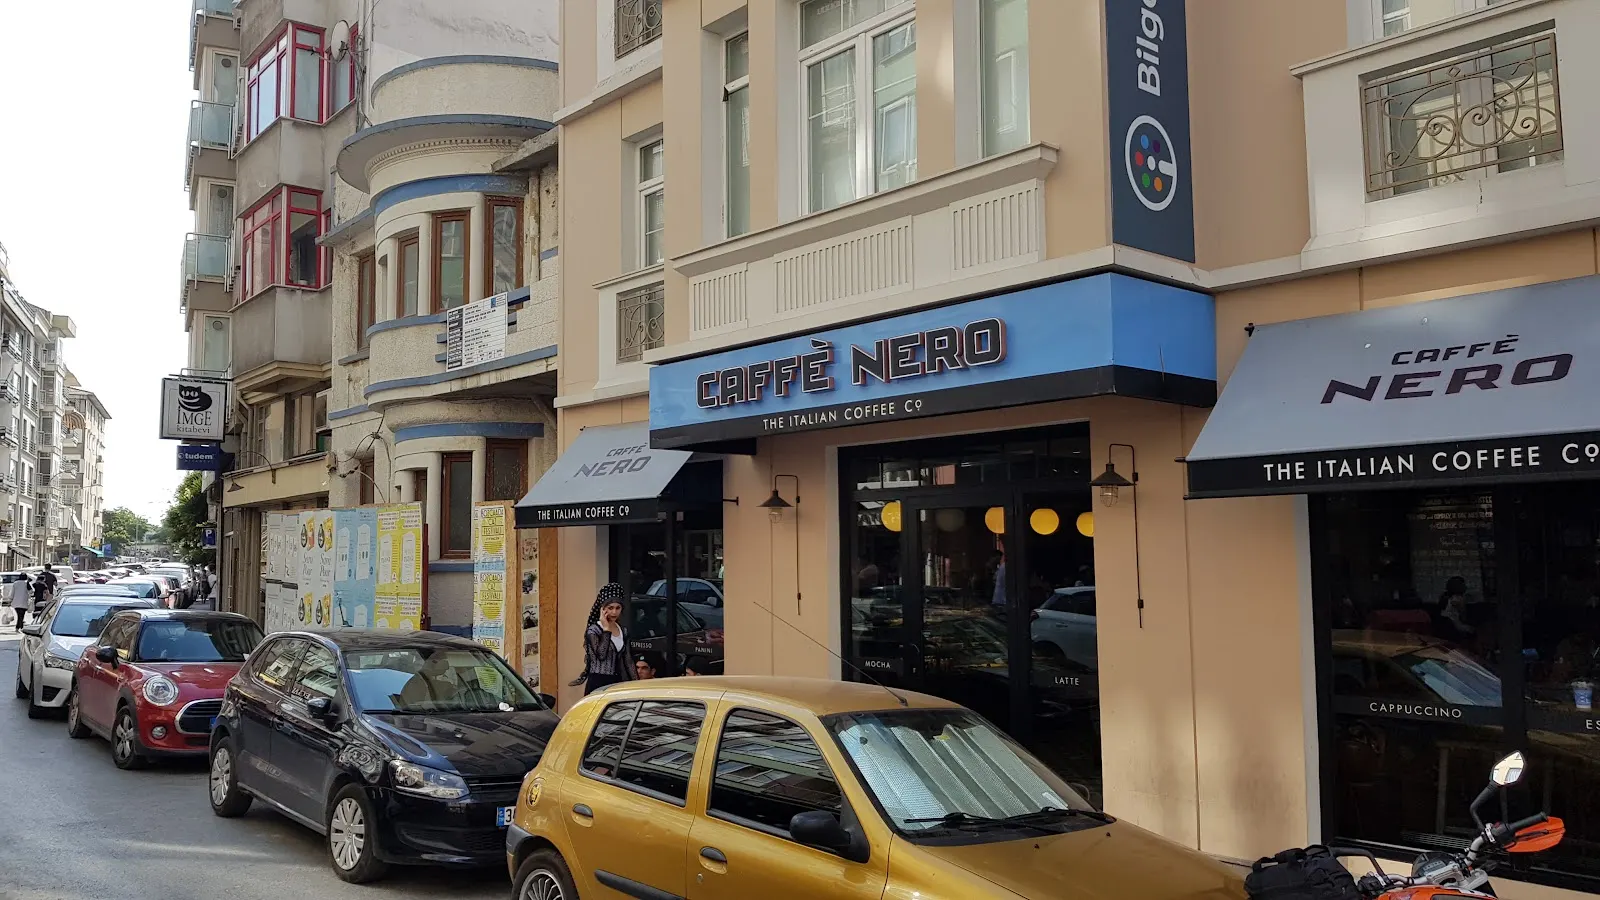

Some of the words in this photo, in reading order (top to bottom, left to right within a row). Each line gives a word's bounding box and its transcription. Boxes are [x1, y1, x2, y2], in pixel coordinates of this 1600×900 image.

[696, 337, 835, 409] CAFFÈ
[850, 317, 1007, 386] NERO
[1320, 353, 1574, 404] NERO
[763, 416, 784, 431] THE
[789, 411, 837, 427] ITALIAN
[844, 402, 895, 420] COFFEE
[176, 425, 210, 434] kitabevi
[184, 452, 213, 460] tudem
[573, 455, 651, 478] NERO
[1263, 461, 1306, 482] THE
[1316, 454, 1414, 480] ITALIAN
[1432, 446, 1540, 472] COFFEE
[537, 510, 551, 521] THE
[553, 508, 582, 519] ITALIAN
[585, 506, 615, 518] COFFEE
[695, 646, 713, 654] PANINI
[865, 660, 891, 669] MOCHA
[1054, 676, 1080, 686] LATTE
[1369, 702, 1462, 719] CAPPUCCINO
[505, 808, 515, 823] 3
